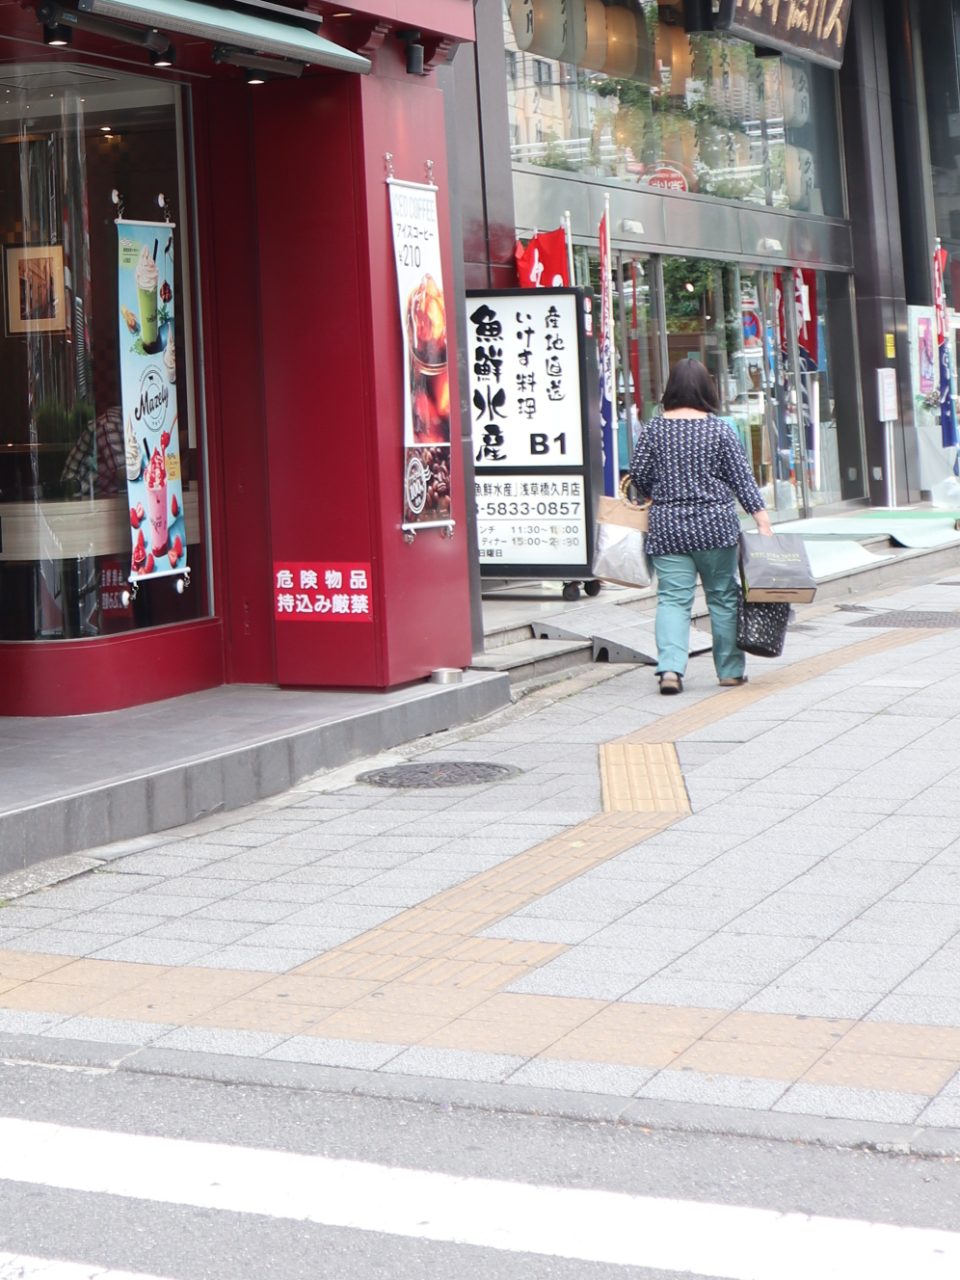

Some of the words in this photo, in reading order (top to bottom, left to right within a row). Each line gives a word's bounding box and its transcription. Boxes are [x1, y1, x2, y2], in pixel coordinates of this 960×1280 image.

[470, 304, 507, 462] 魚鮮水産
[516, 312, 536, 419] いけす料理
[544, 305, 566, 402] 産地直送
[529, 432, 567, 455] B1
[276, 570, 368, 590] 危険物品
[276, 593, 369, 615] 持込み厳禁
